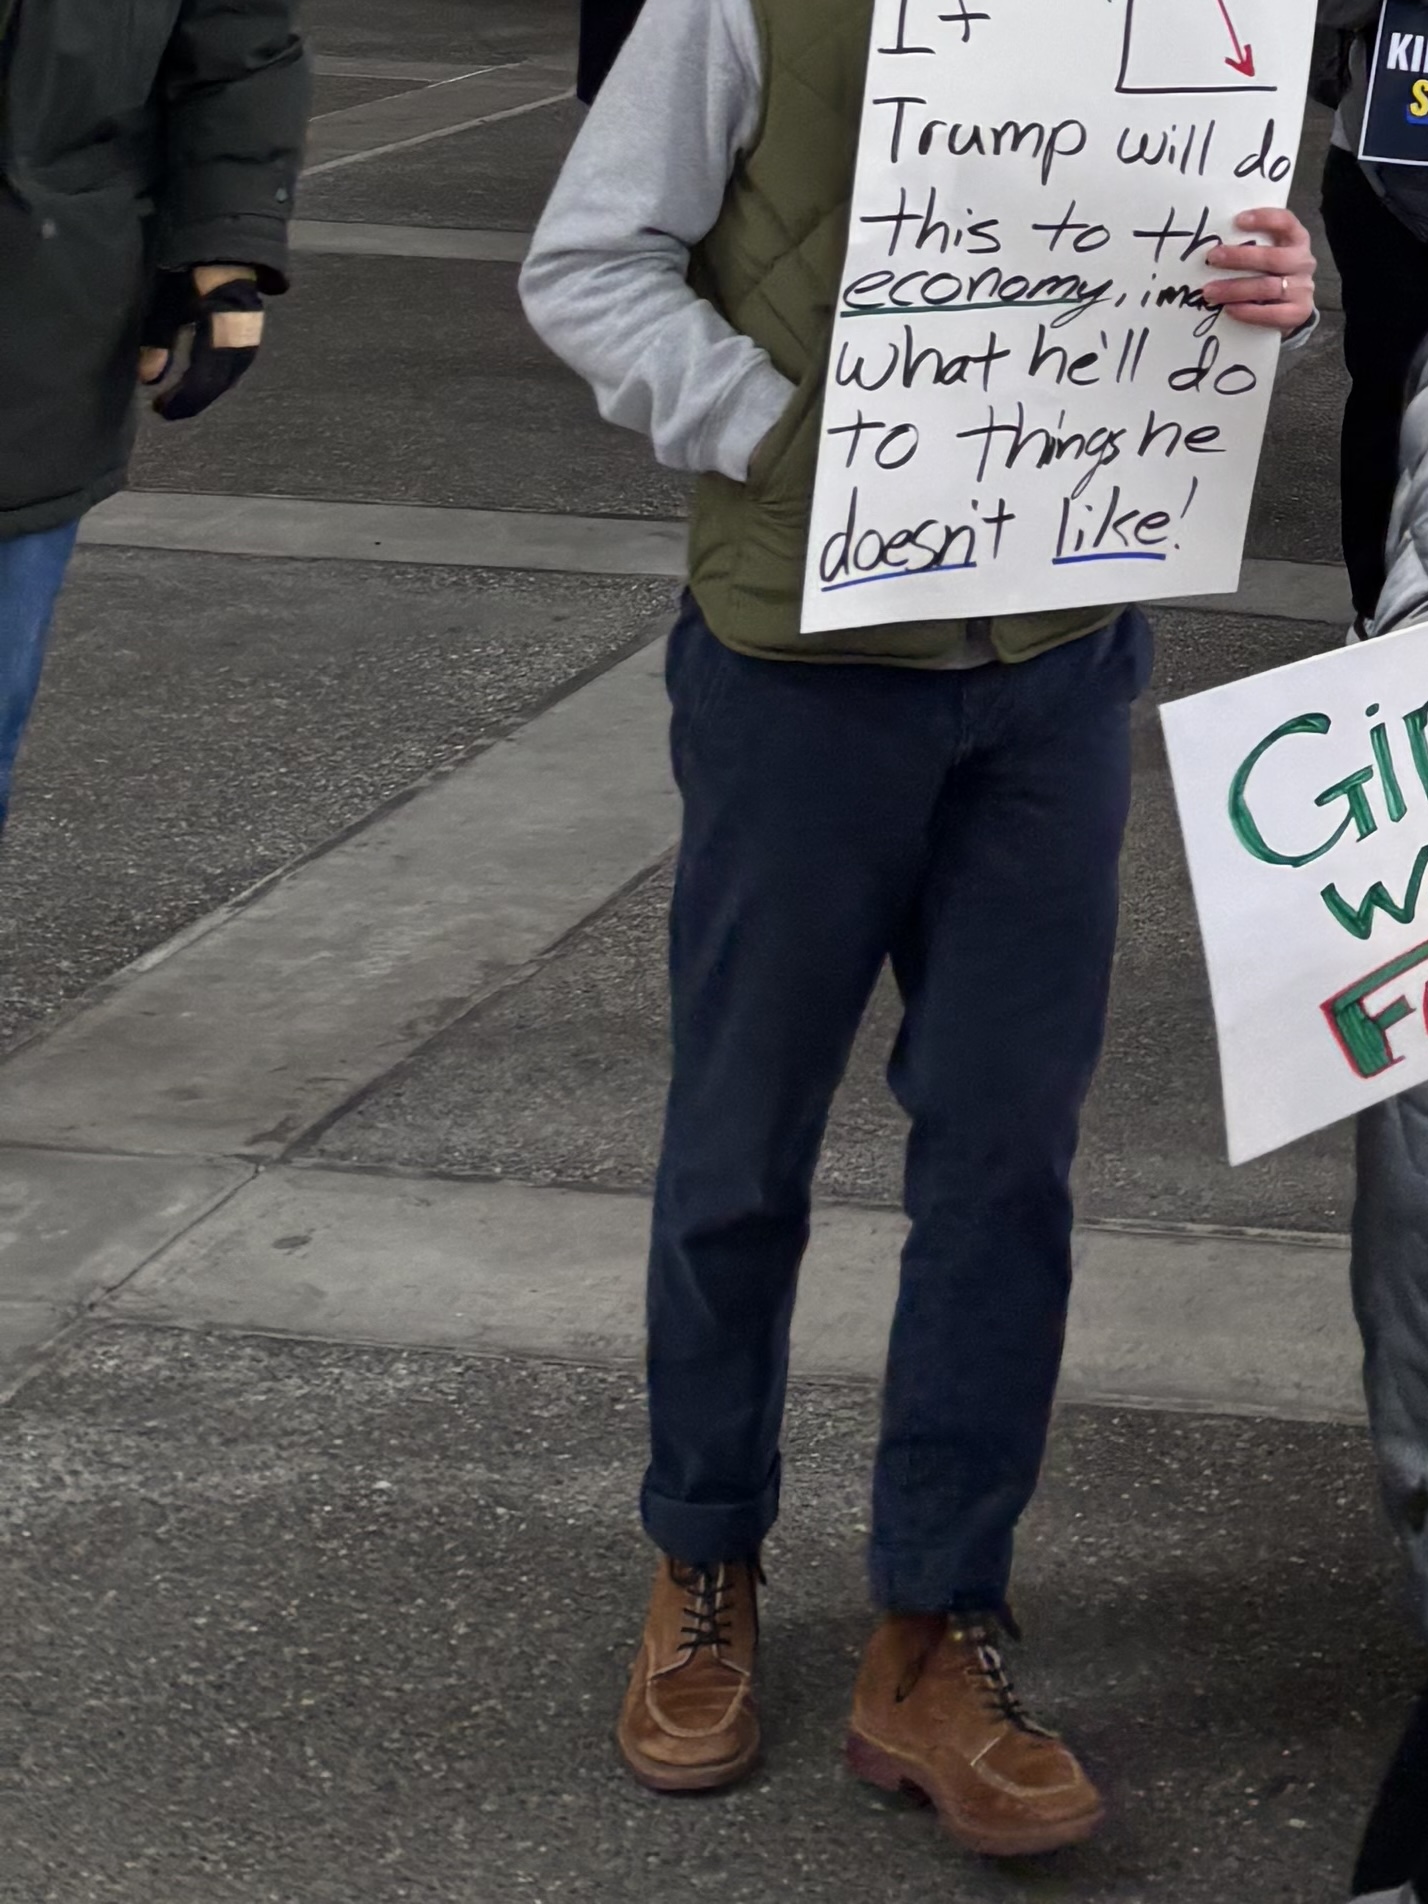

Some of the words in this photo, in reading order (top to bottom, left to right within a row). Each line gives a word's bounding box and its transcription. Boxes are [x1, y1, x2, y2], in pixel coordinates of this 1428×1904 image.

[873, 96, 1087, 185] Trump
[1117, 120, 1215, 175] will
[1234, 119, 1291, 183] do
[860, 187, 1001, 256] this
[1032, 200, 1111, 260] to
[1133, 206, 1256, 263] th
[834, 324, 1010, 391] what
[1028, 323, 1149, 386] he'll
[1168, 336, 1257, 395] do
[827, 409, 919, 469] to
[957, 402, 1120, 499] things
[1138, 410, 1226, 457] he
[820, 486, 1016, 582] doesn't
[1055, 476, 1198, 552] like!
